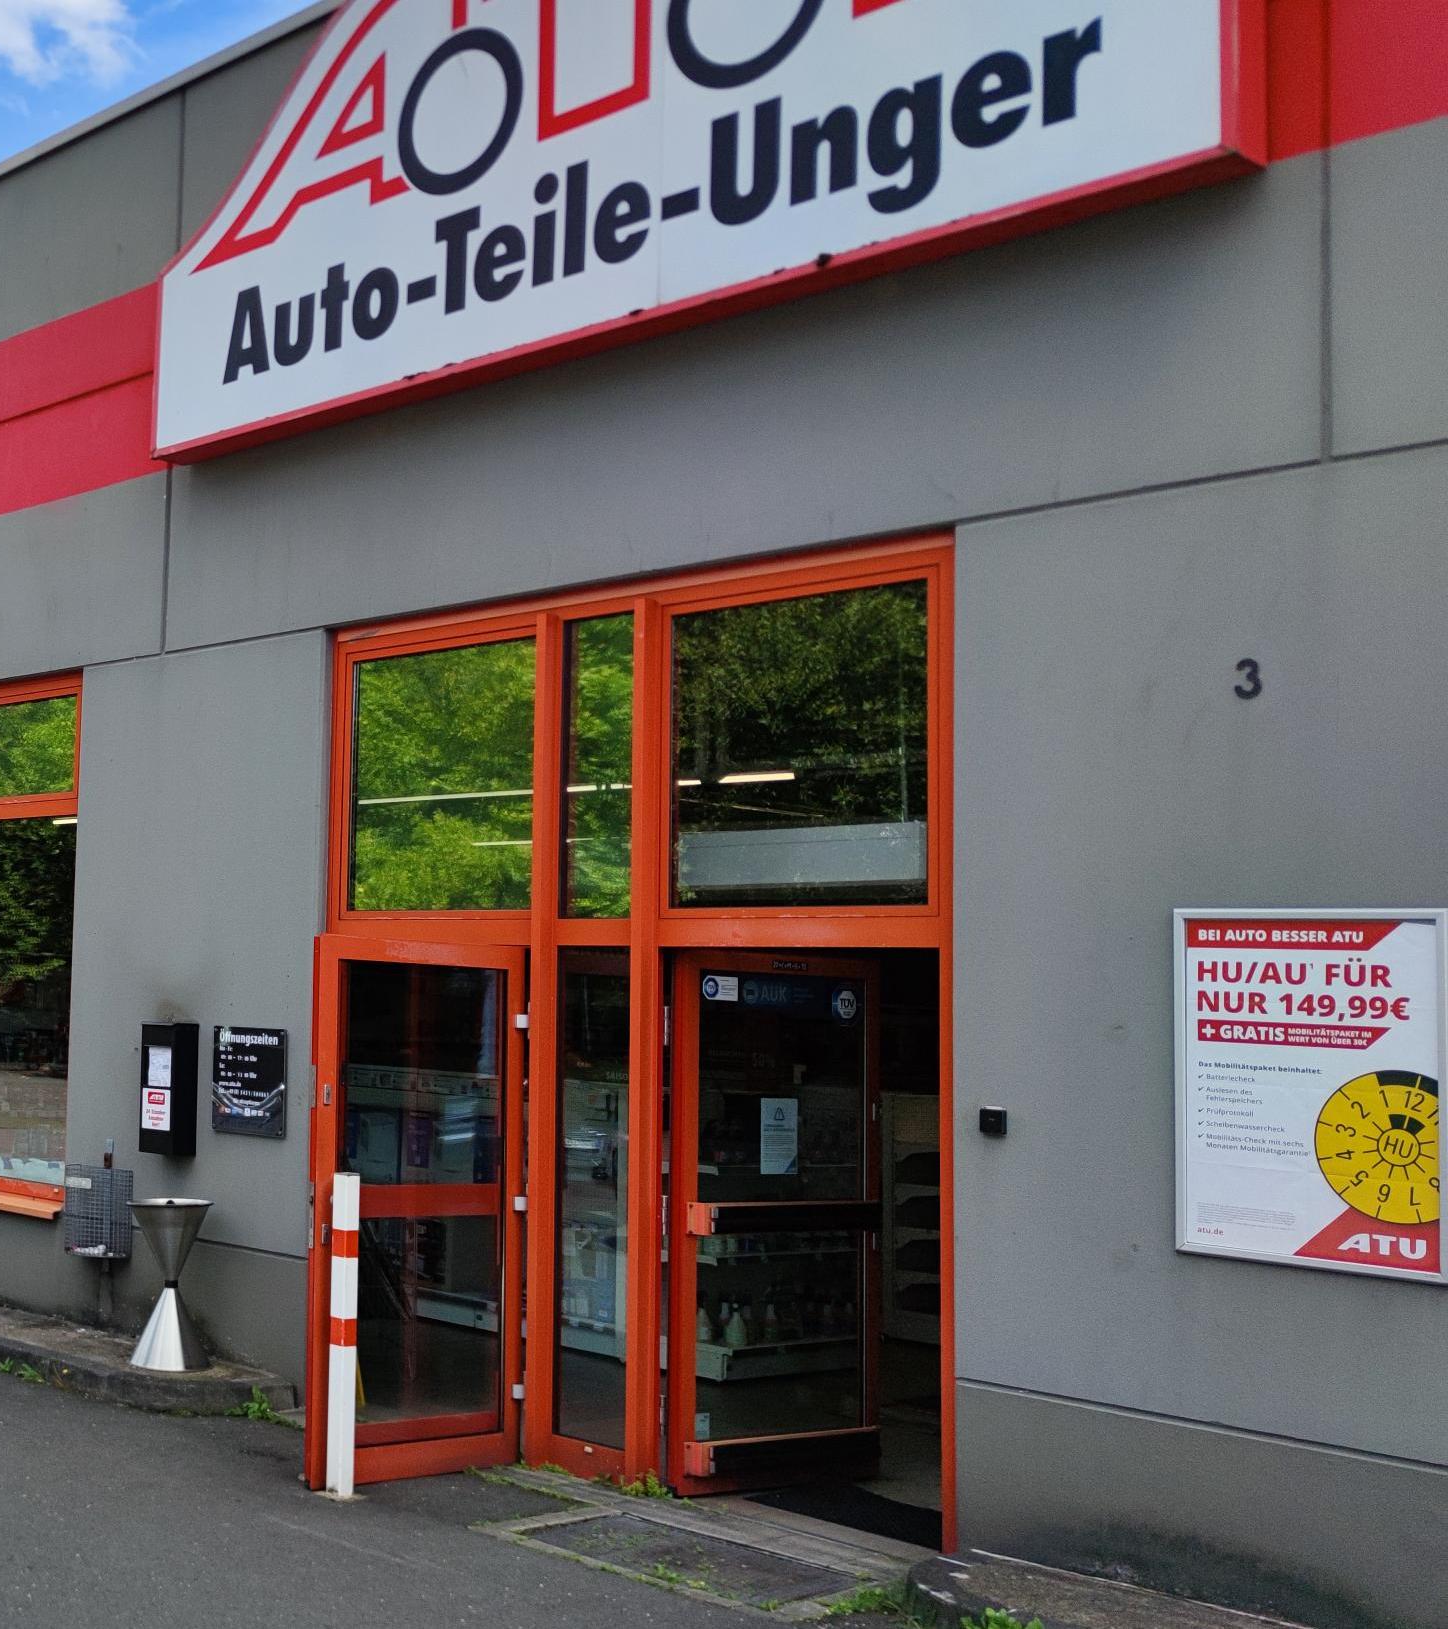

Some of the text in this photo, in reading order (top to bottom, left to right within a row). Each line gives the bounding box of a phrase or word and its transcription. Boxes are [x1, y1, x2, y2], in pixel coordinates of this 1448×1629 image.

[222, 16, 1102, 386] Auto-Teile-Unger
[1234, 658, 1262, 700] 3
[1198, 929, 1364, 944] BEI AUTO BESSER ATU
[1325, 957, 1393, 988] FÜR
[760, 982, 788, 1001] AUK
[839, 997, 855, 1010] TÜV
[1197, 990, 1411, 1022] NUR 149,99€
[219, 1028, 279, 1046] Öffnungszeiten
[1219, 1025, 1285, 1042] GRATIS
[1288, 1028, 1372, 1039] MOBILITÄTSPAKET IM
[1288, 1035, 1368, 1046] WERT VON ÜBER 30€
[1214, 1062, 1276, 1073] Mobilitätspaket
[1206, 1074, 1255, 1083] Batteriecheck
[1206, 1086, 1253, 1096] Auslesen des
[1379, 1090, 1389, 1108] 1
[1404, 1090, 1425, 1112] 12
[1351, 1101, 1371, 1119] 2
[1335, 1123, 1357, 1137] 3
[1335, 1149, 1355, 1160] 4
[1383, 1135, 1414, 1159] HU
[1350, 1170, 1369, 1187] 5
[1197, 1226, 1225, 1236] atu.de
[1337, 1233, 1427, 1260] ATU
